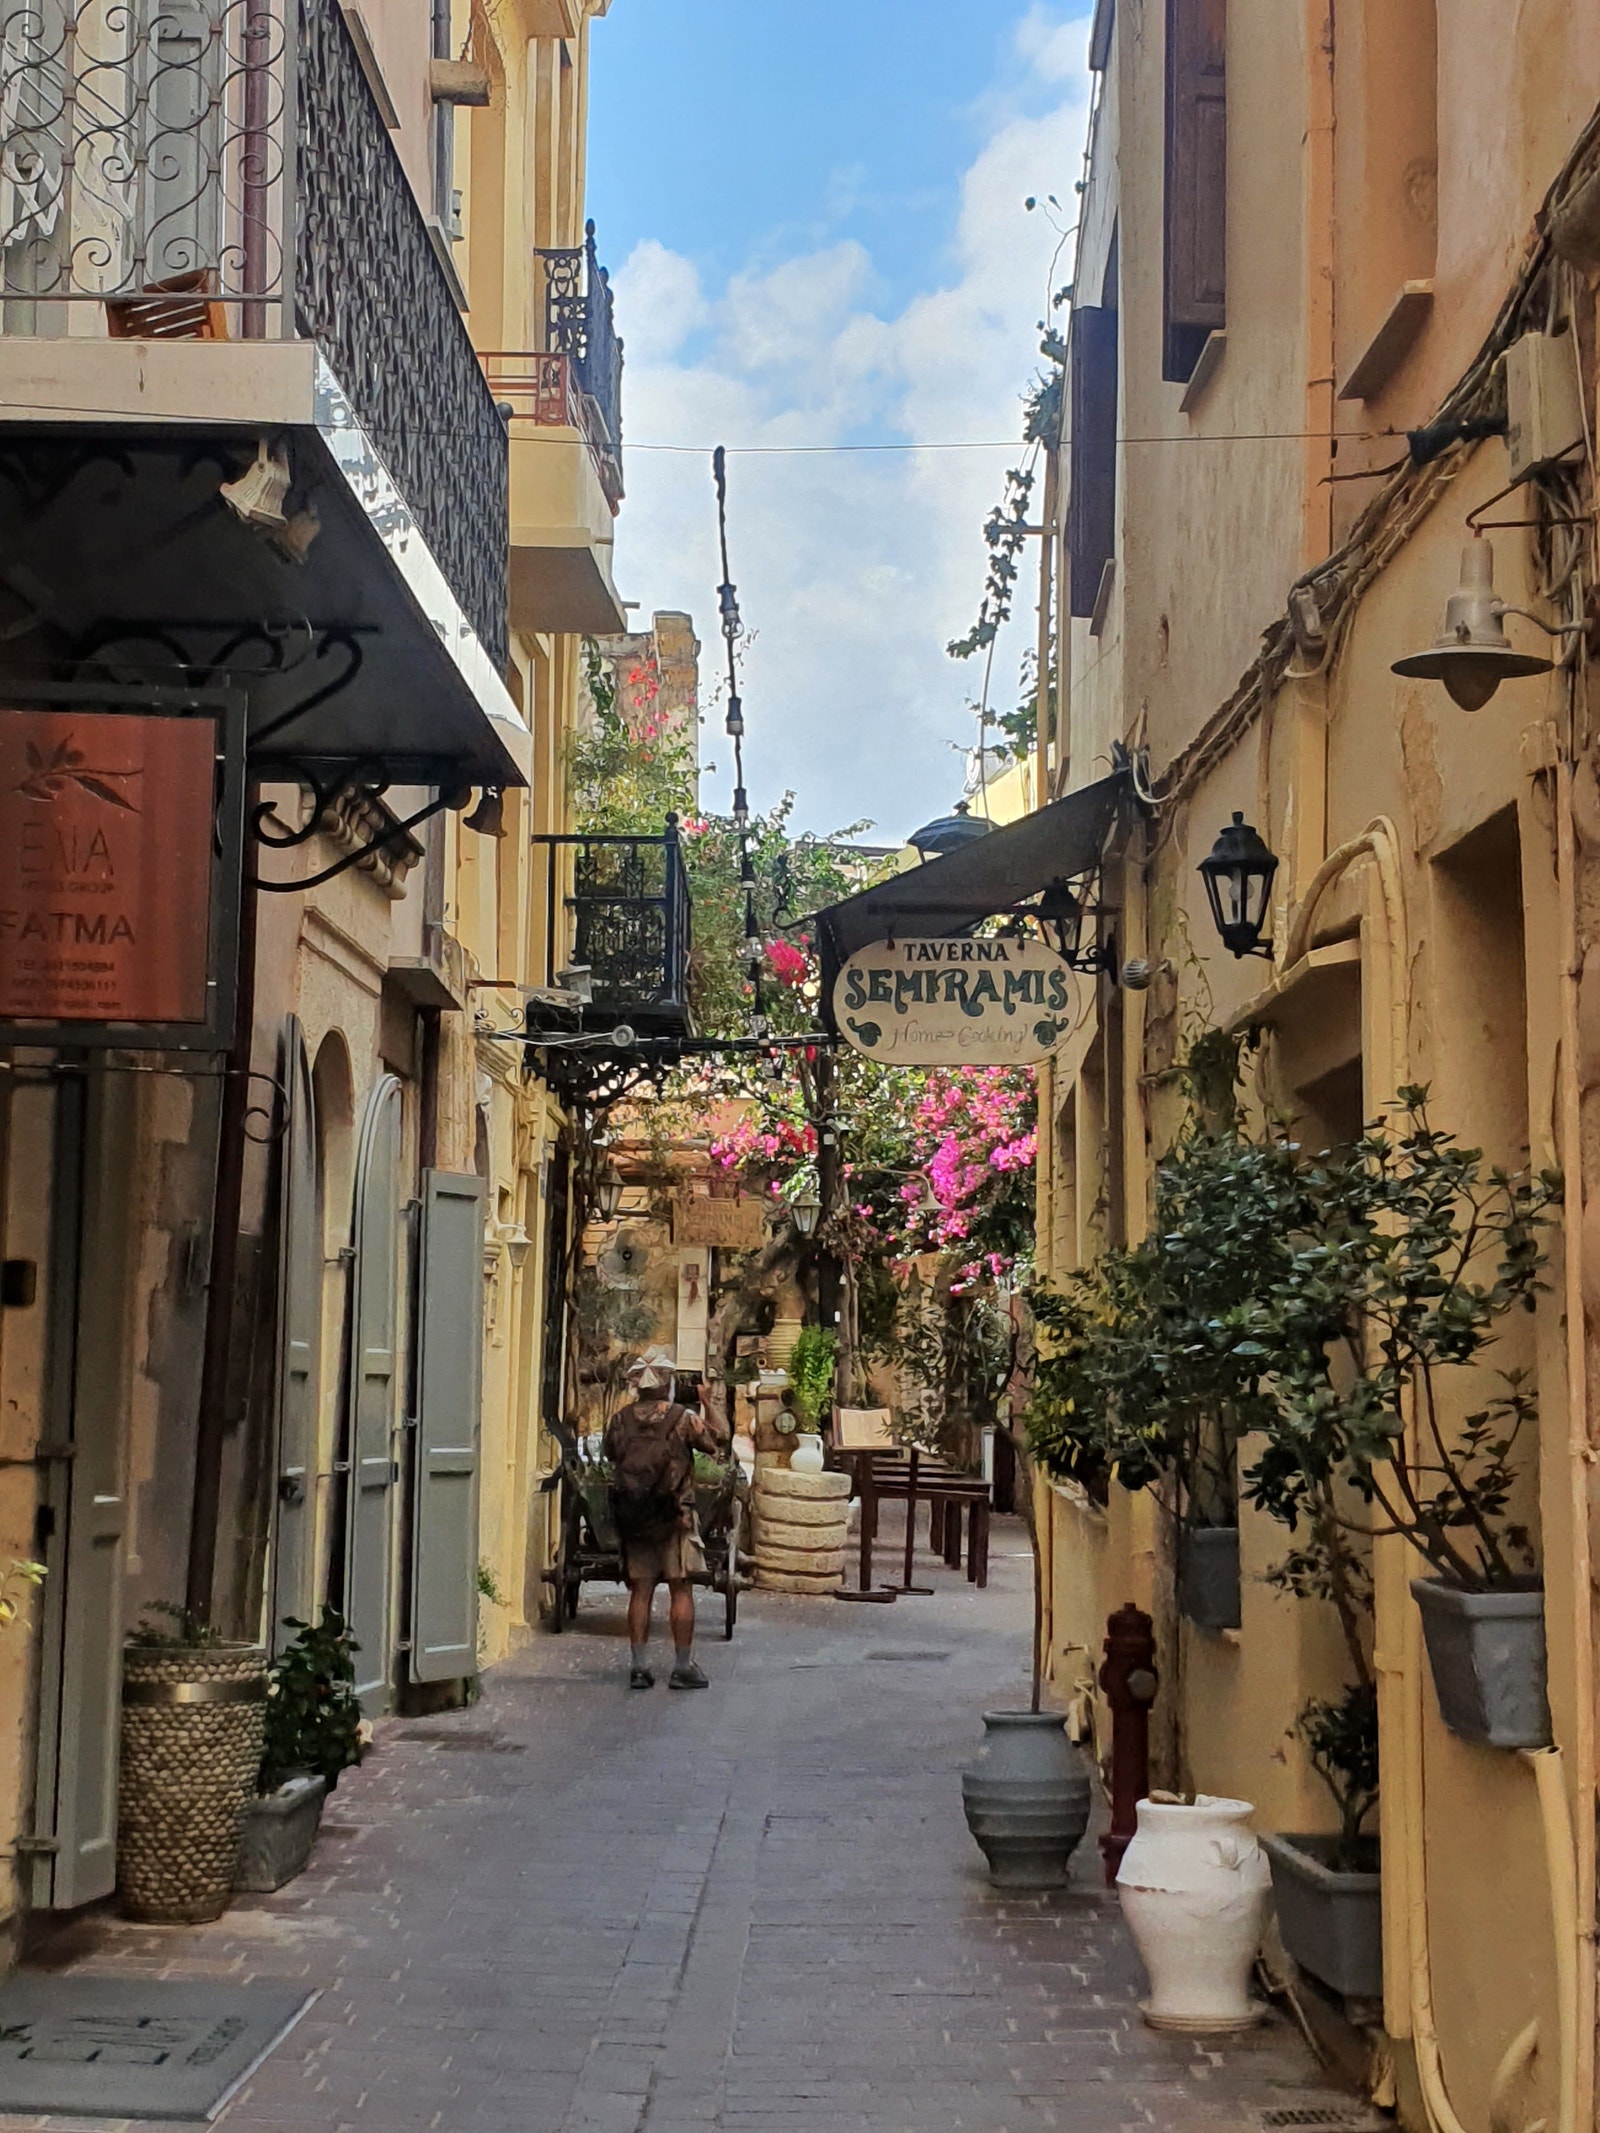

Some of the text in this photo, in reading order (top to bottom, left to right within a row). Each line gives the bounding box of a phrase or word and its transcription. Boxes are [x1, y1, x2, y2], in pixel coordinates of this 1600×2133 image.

[0, 910, 136, 945] FATMA
[903, 942, 1010, 963] TAVERNA
[844, 968, 1069, 1017] SEMIRAMIS
[886, 1019, 1029, 1054] Home Cooking
